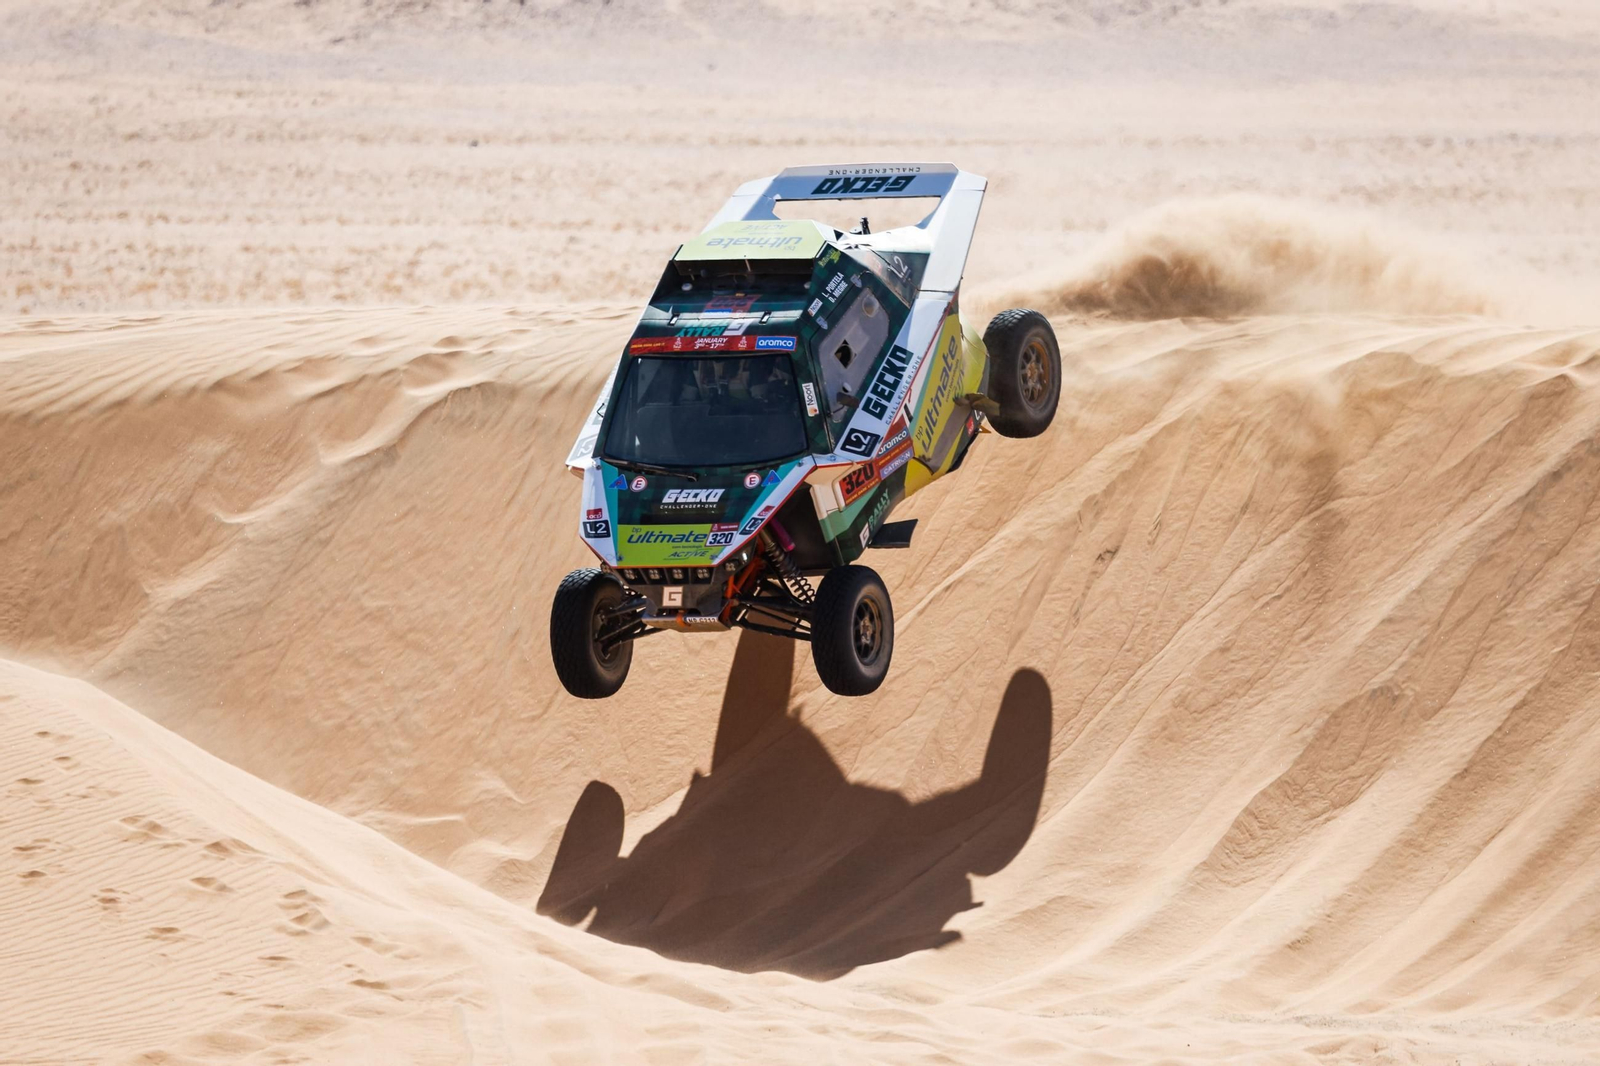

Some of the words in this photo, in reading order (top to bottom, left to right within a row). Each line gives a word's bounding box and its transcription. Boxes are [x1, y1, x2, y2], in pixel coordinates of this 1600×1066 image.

[810, 175, 917, 195] GECKO
[706, 235, 804, 249] ultimate
[826, 271, 845, 292] PORTELA
[675, 326, 726, 338] RALLY
[758, 339, 794, 348] aramco
[861, 344, 914, 421] GECKO
[921, 335, 959, 454] ultimate
[845, 432, 871, 452] L2
[842, 462, 876, 495] 320
[661, 488, 726, 504] GECKO
[586, 522, 608, 534] L2
[631, 527, 642, 535] bp
[626, 530, 708, 544] ultimate
[709, 532, 734, 545] 320
